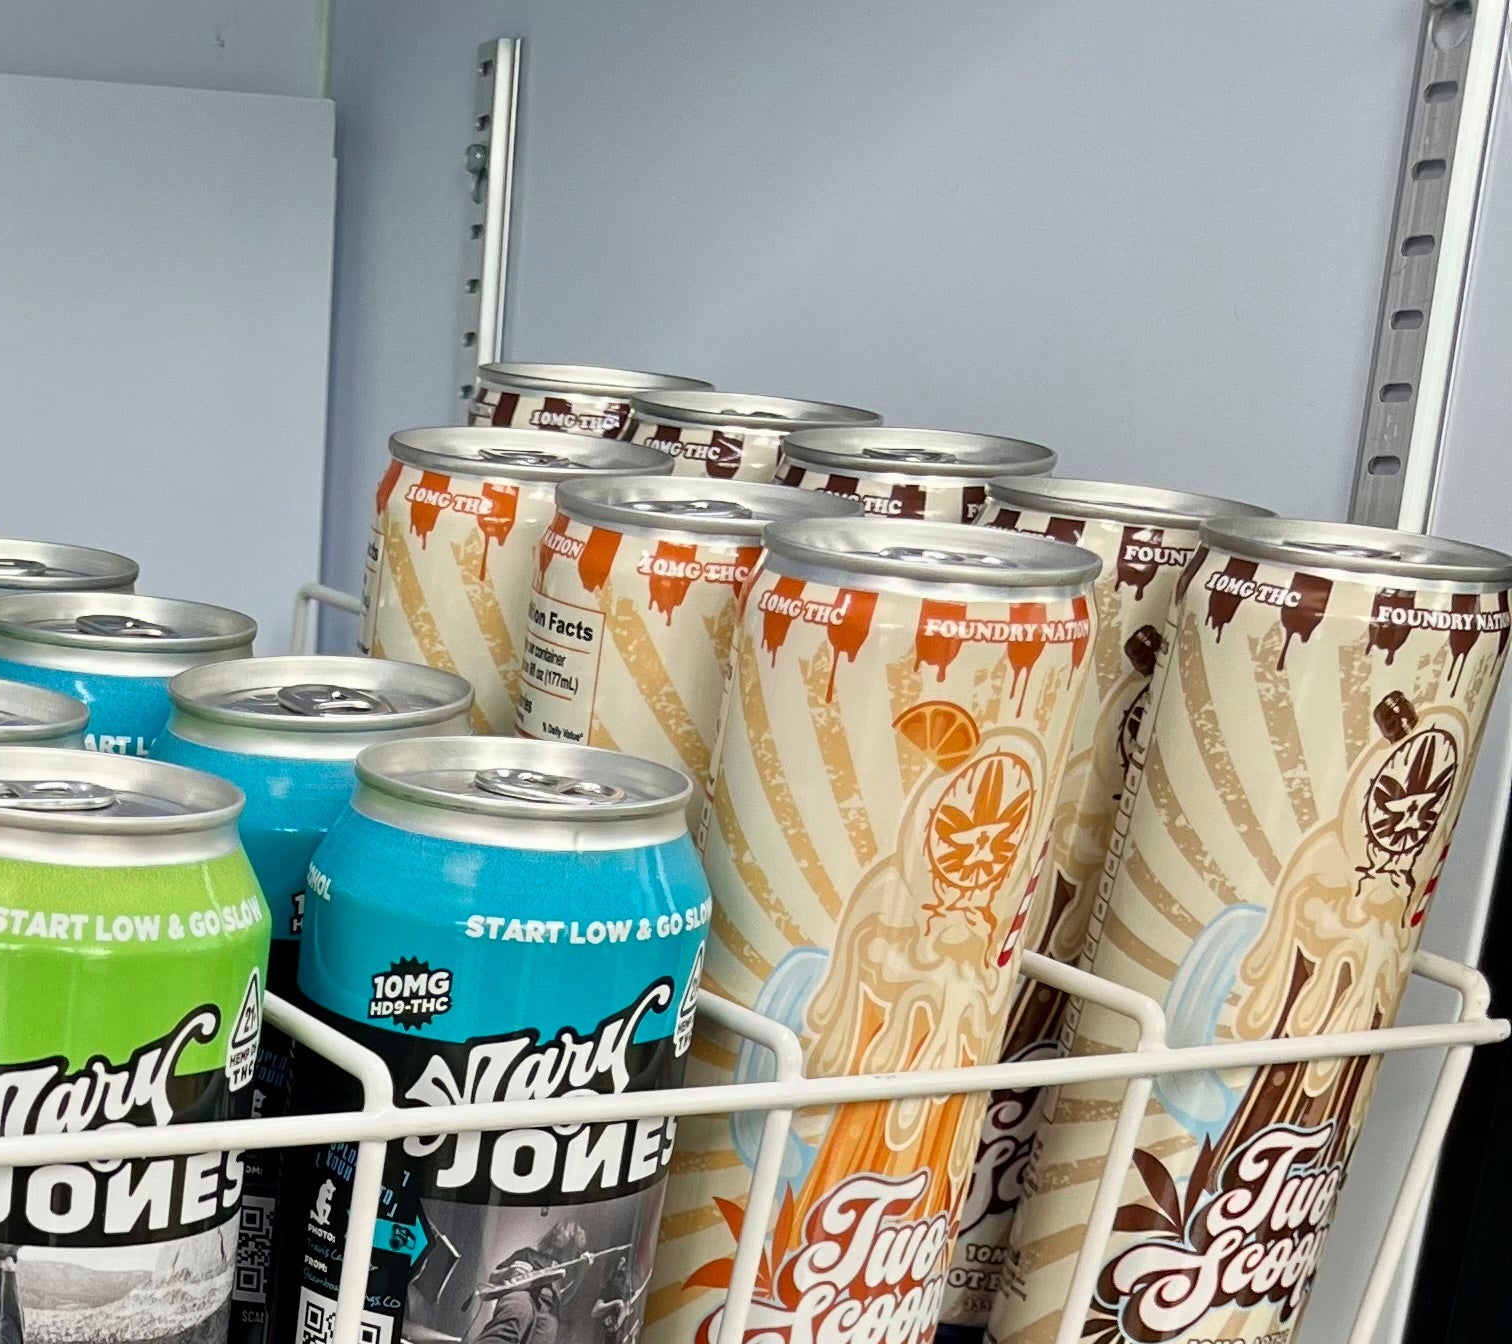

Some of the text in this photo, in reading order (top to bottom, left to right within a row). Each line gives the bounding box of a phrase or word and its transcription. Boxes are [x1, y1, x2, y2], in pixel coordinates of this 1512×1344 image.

[406, 485, 451, 507] 10MG
[705, 562, 750, 582] THC
[1206, 571, 1302, 608] 10MG THC
[760, 590, 847, 626] 10MG THC
[1377, 605, 1475, 631] FOUNDRY
[548, 611, 594, 643] Facts
[924, 617, 1040, 642] FOUNDRY
[95, 914, 162, 943] LOW
[167, 913, 185, 940] &
[189, 908, 221, 937] GO
[223, 896, 263, 933] SLOW
[464, 911, 683, 945] START LOW & GO
[372, 971, 451, 998] 10MG
[369, 997, 449, 1018] HD9-THC
[402, 984, 671, 1158] Mary
[436, 1116, 679, 1195] JONES
